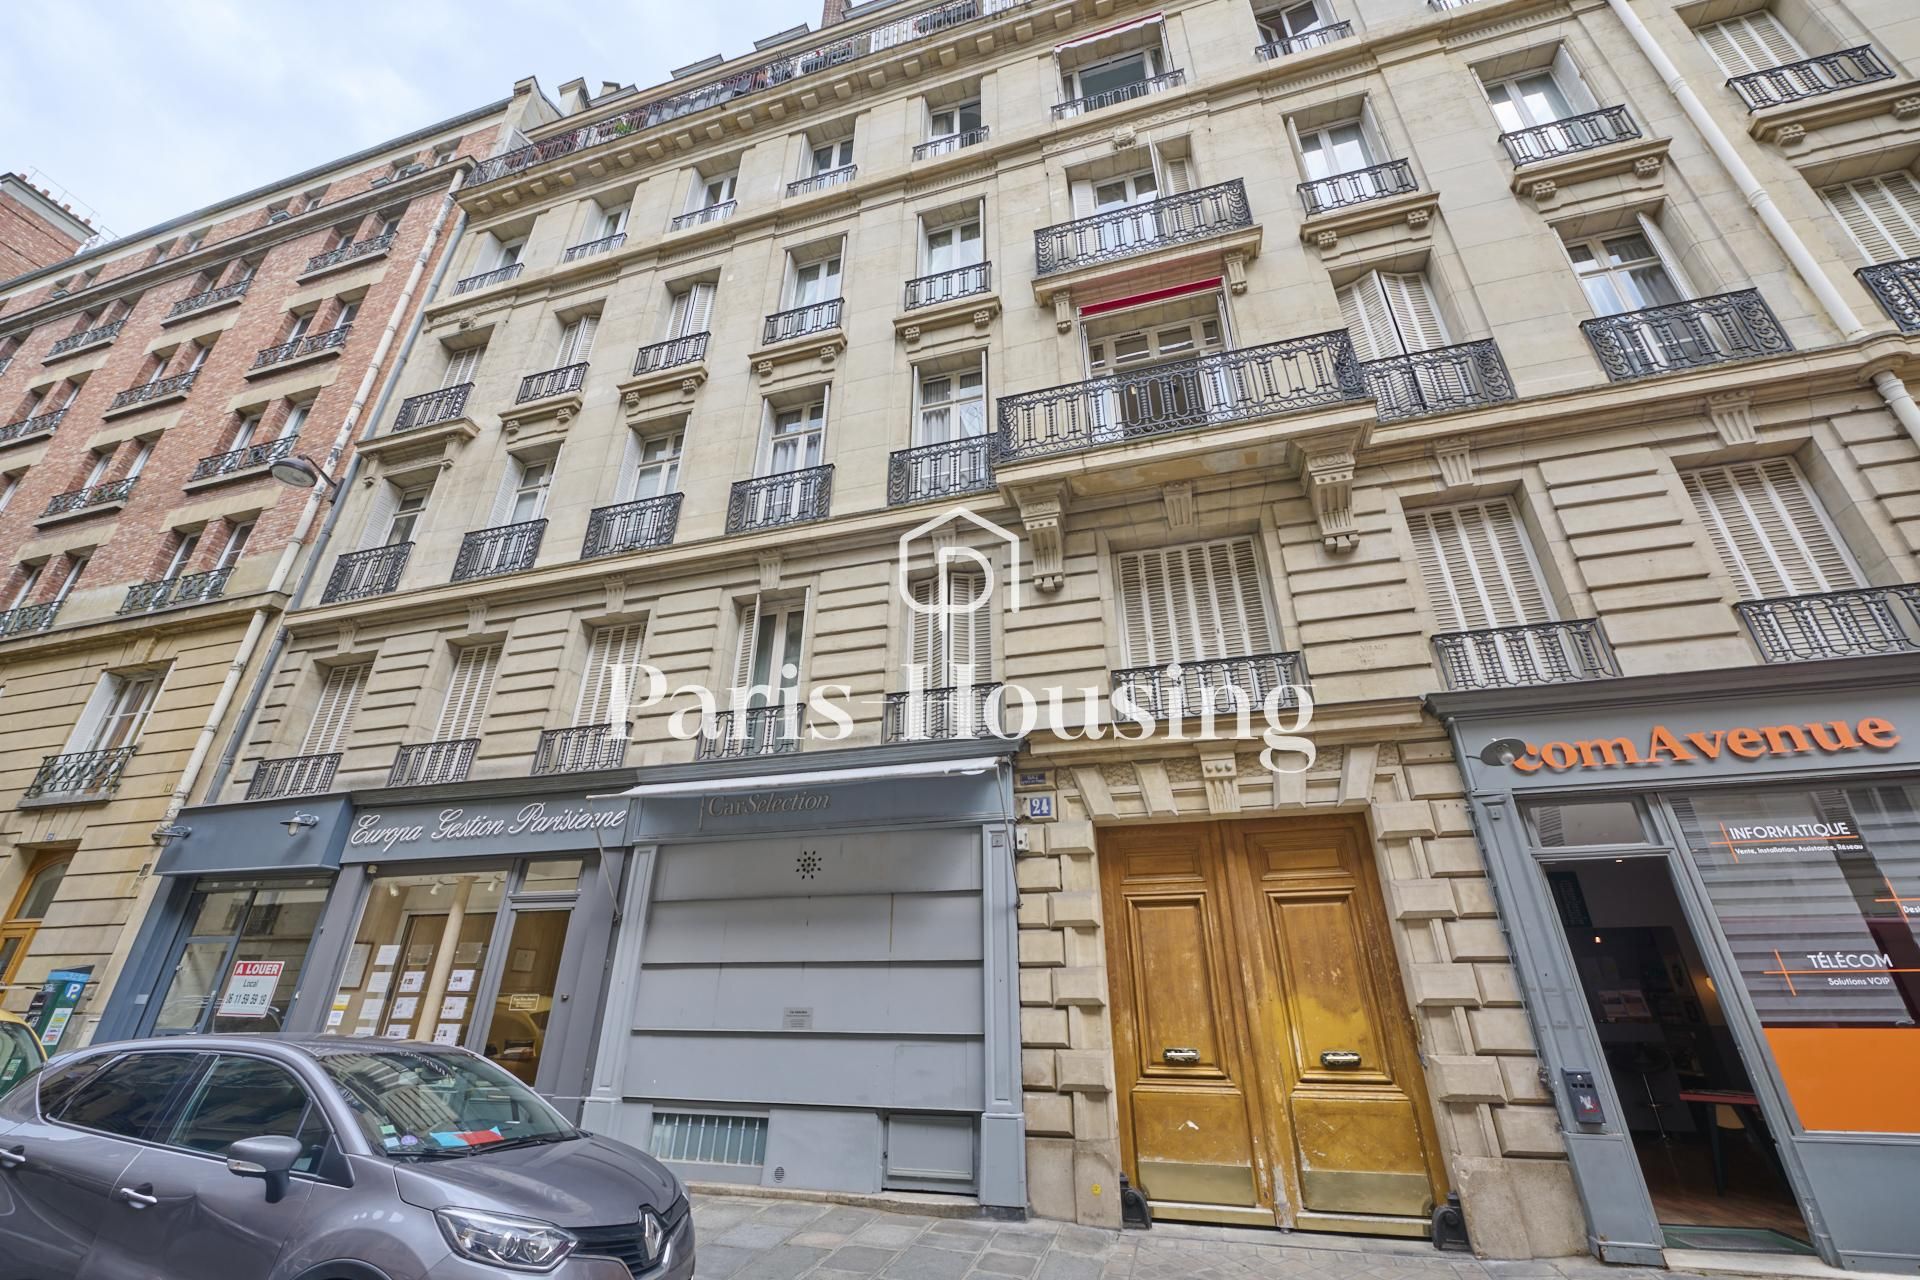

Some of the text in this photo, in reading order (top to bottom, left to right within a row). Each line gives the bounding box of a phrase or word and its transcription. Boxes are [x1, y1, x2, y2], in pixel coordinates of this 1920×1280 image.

[1512, 716, 1901, 771] comAvenue
[708, 791, 830, 817] CarSelection
[1031, 798, 1049, 815] 24
[350, 801, 627, 852] Europa Gestion Parisienne
[1729, 822, 1851, 840] INFORMATIQUE
[1734, 847, 1757, 855] Vente,
[1836, 843, 1863, 851] Réseau
[1806, 951, 1894, 969] TÉLÉCOM
[236, 963, 280, 975] A LOUER
[242, 979, 259, 988] Local
[1827, 976, 1890, 986] Solutions VOIP
